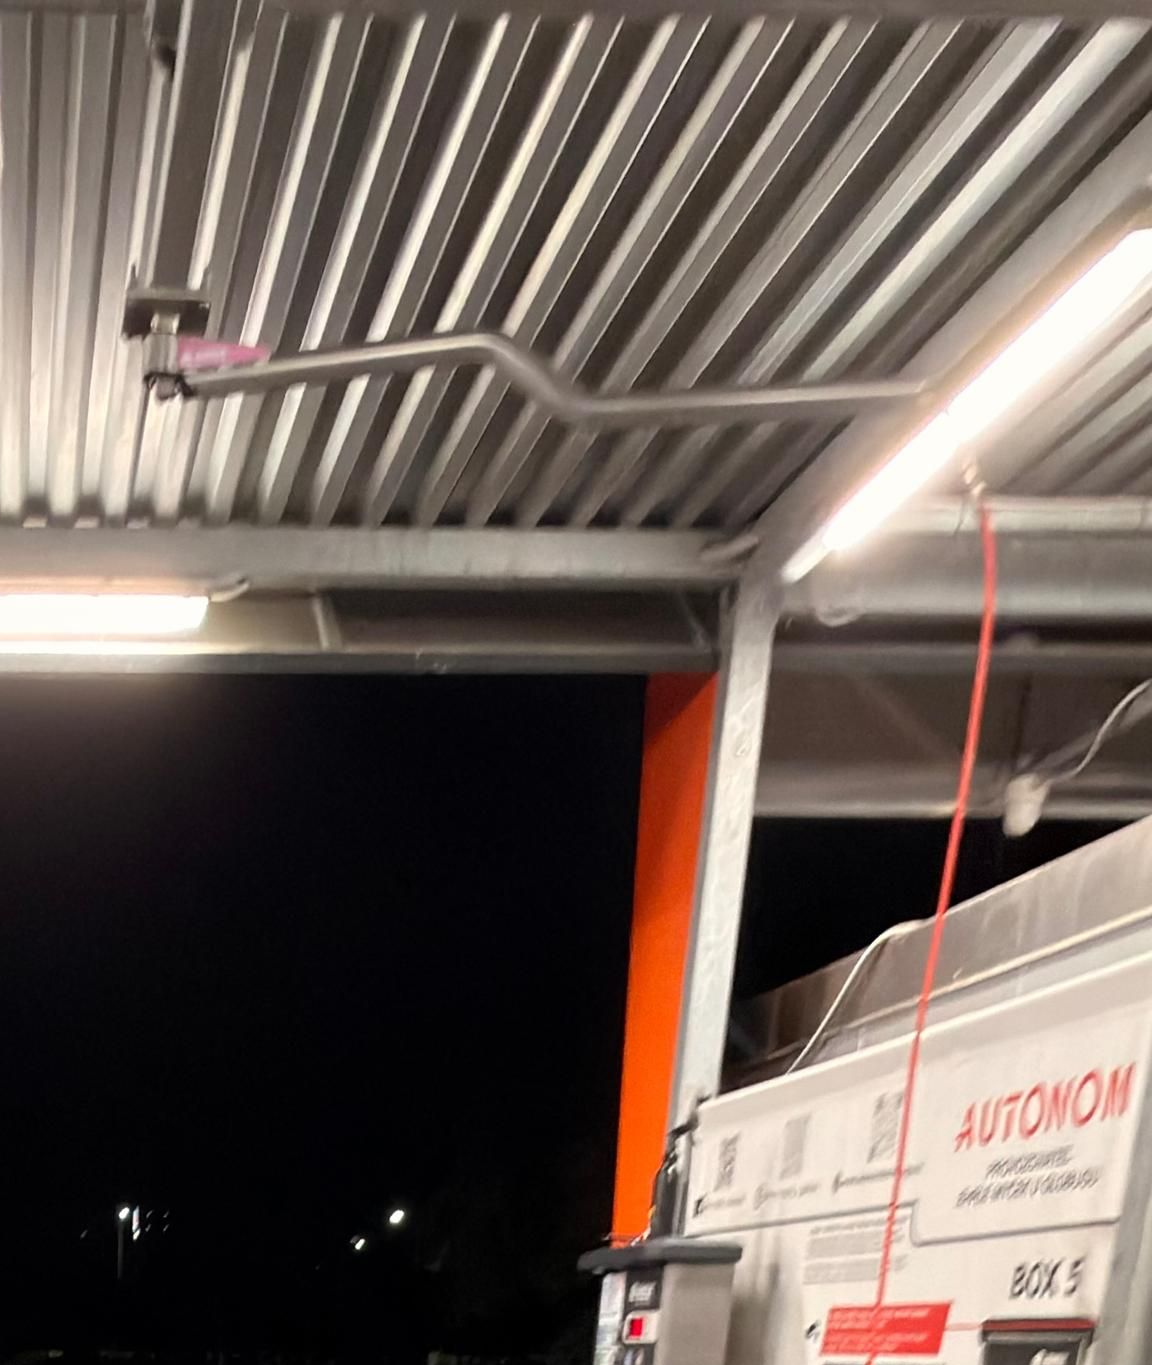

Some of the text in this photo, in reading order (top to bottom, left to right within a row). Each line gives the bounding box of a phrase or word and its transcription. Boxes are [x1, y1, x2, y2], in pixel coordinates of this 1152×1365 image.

[954, 1062, 1136, 1152] AUTONOM
[1009, 1256, 1086, 1299] BOX 5
